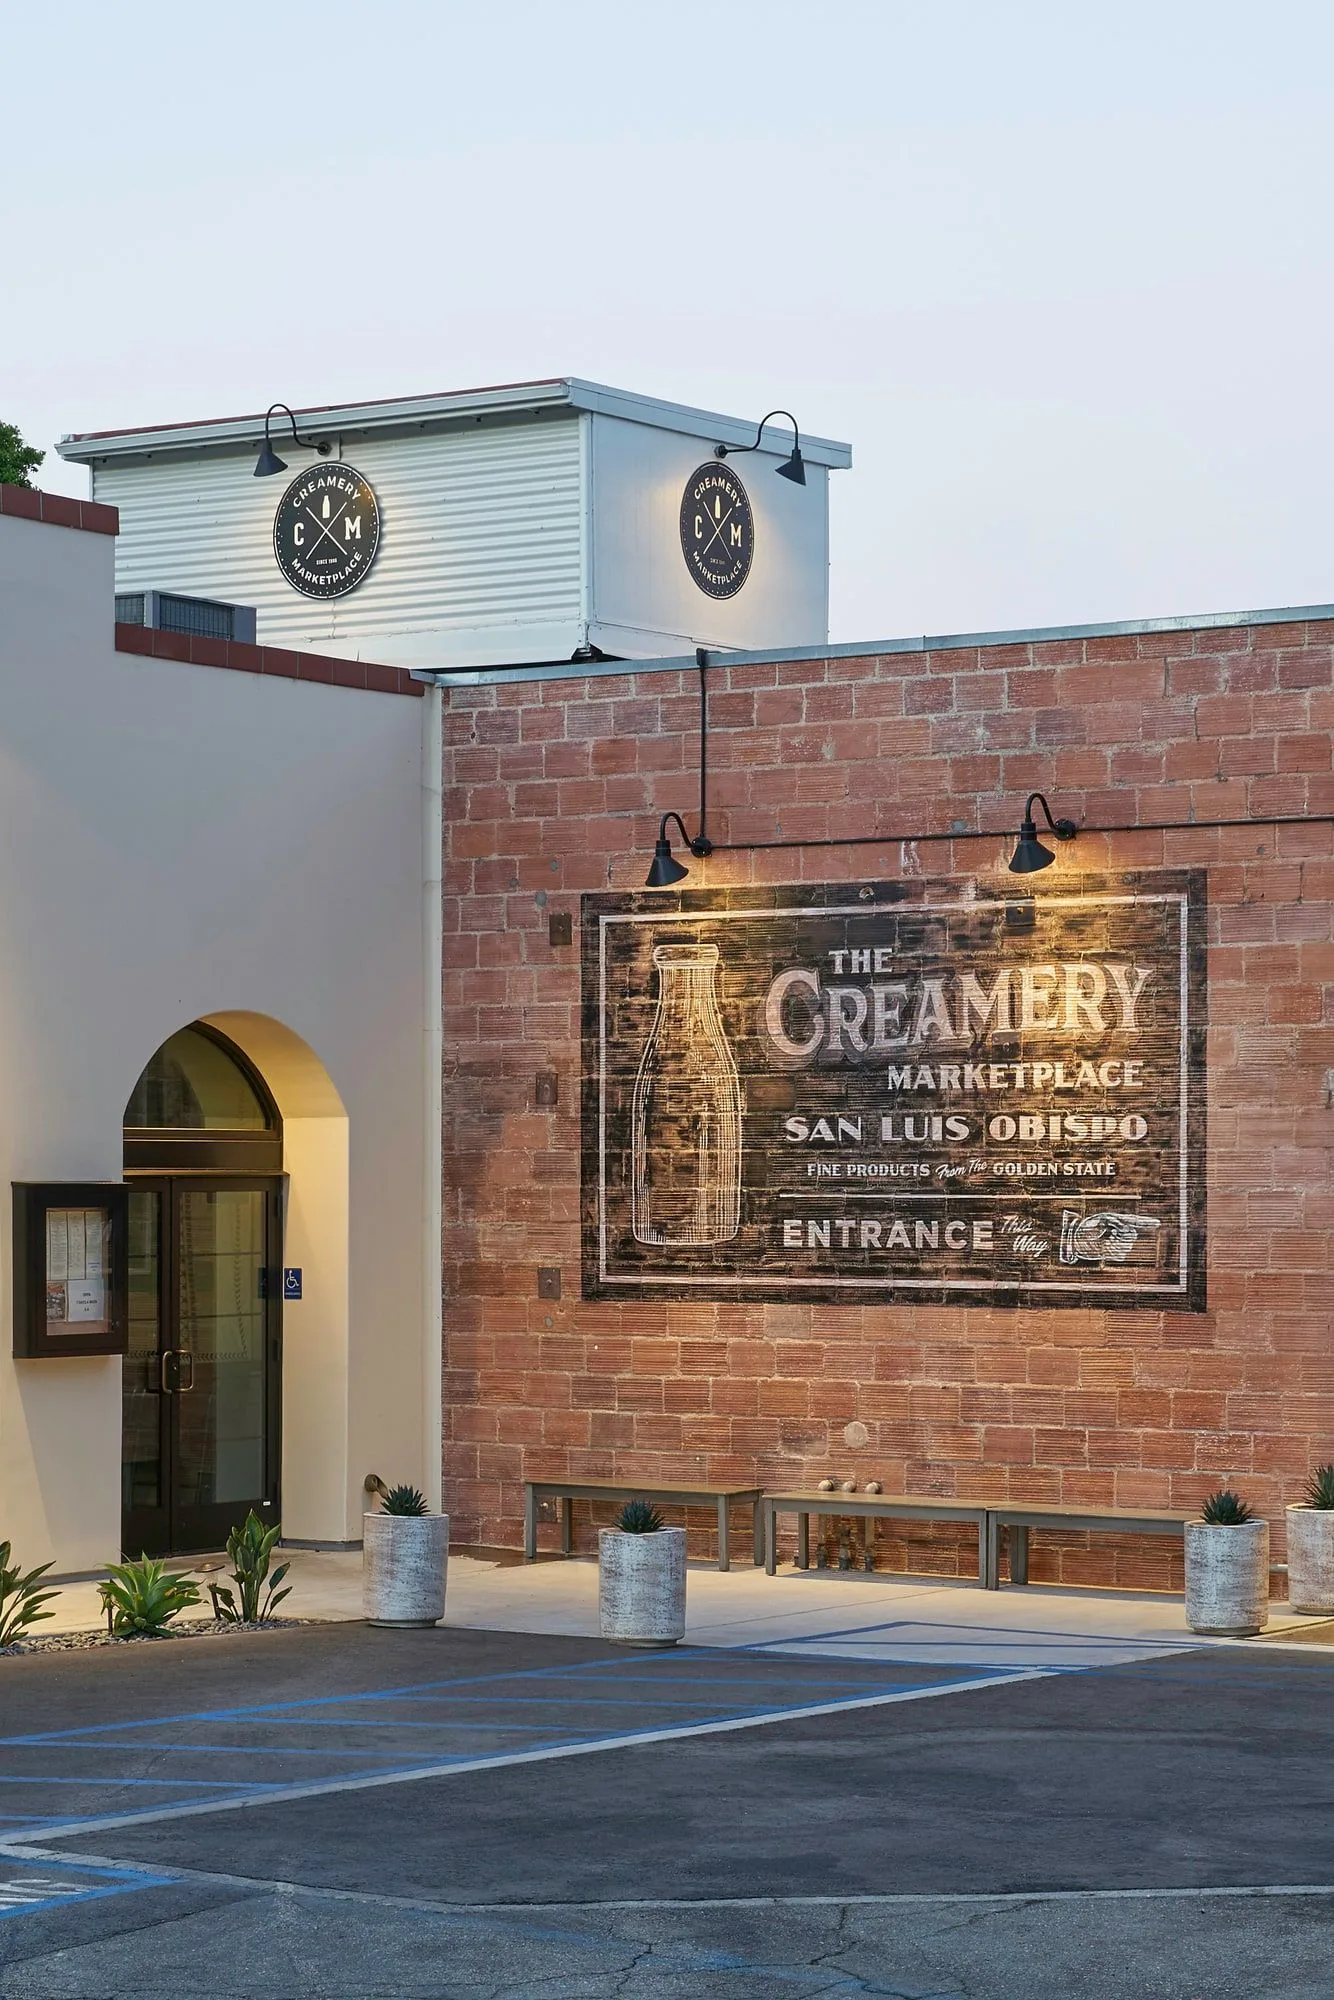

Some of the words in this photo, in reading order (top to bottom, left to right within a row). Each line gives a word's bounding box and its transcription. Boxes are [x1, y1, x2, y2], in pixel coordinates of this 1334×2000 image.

[293, 475, 361, 508] CREAMERY
[694, 477, 742, 508] CREAMERY
[293, 522, 305, 546] C
[344, 515, 361, 540] M
[694, 515, 702, 539] C
[730, 522, 742, 548] M
[291, 551, 362, 585] MARKETPLACE
[692, 550, 742, 585] MARKETPLACE
[828, 948, 892, 974] THE
[765, 961, 1154, 1056] CREAMERY
[887, 1060, 1143, 1090] MARKETPLACE
[785, 1116, 862, 1142] SAN
[881, 1115, 970, 1141] LUIS
[988, 1114, 1148, 1141] OBISPO
[807, 1163, 841, 1177] FINE
[847, 1163, 930, 1177] PRODUCTS
[935, 1163, 966, 1180] From
[968, 1158, 988, 1173] The
[993, 1162, 1058, 1176] GOLDEN
[1062, 1162, 1116, 1176] STATE
[783, 1219, 994, 1250] ENTRANCE
[1000, 1214, 1034, 1234] This
[1012, 1235, 1048, 1258] Way
